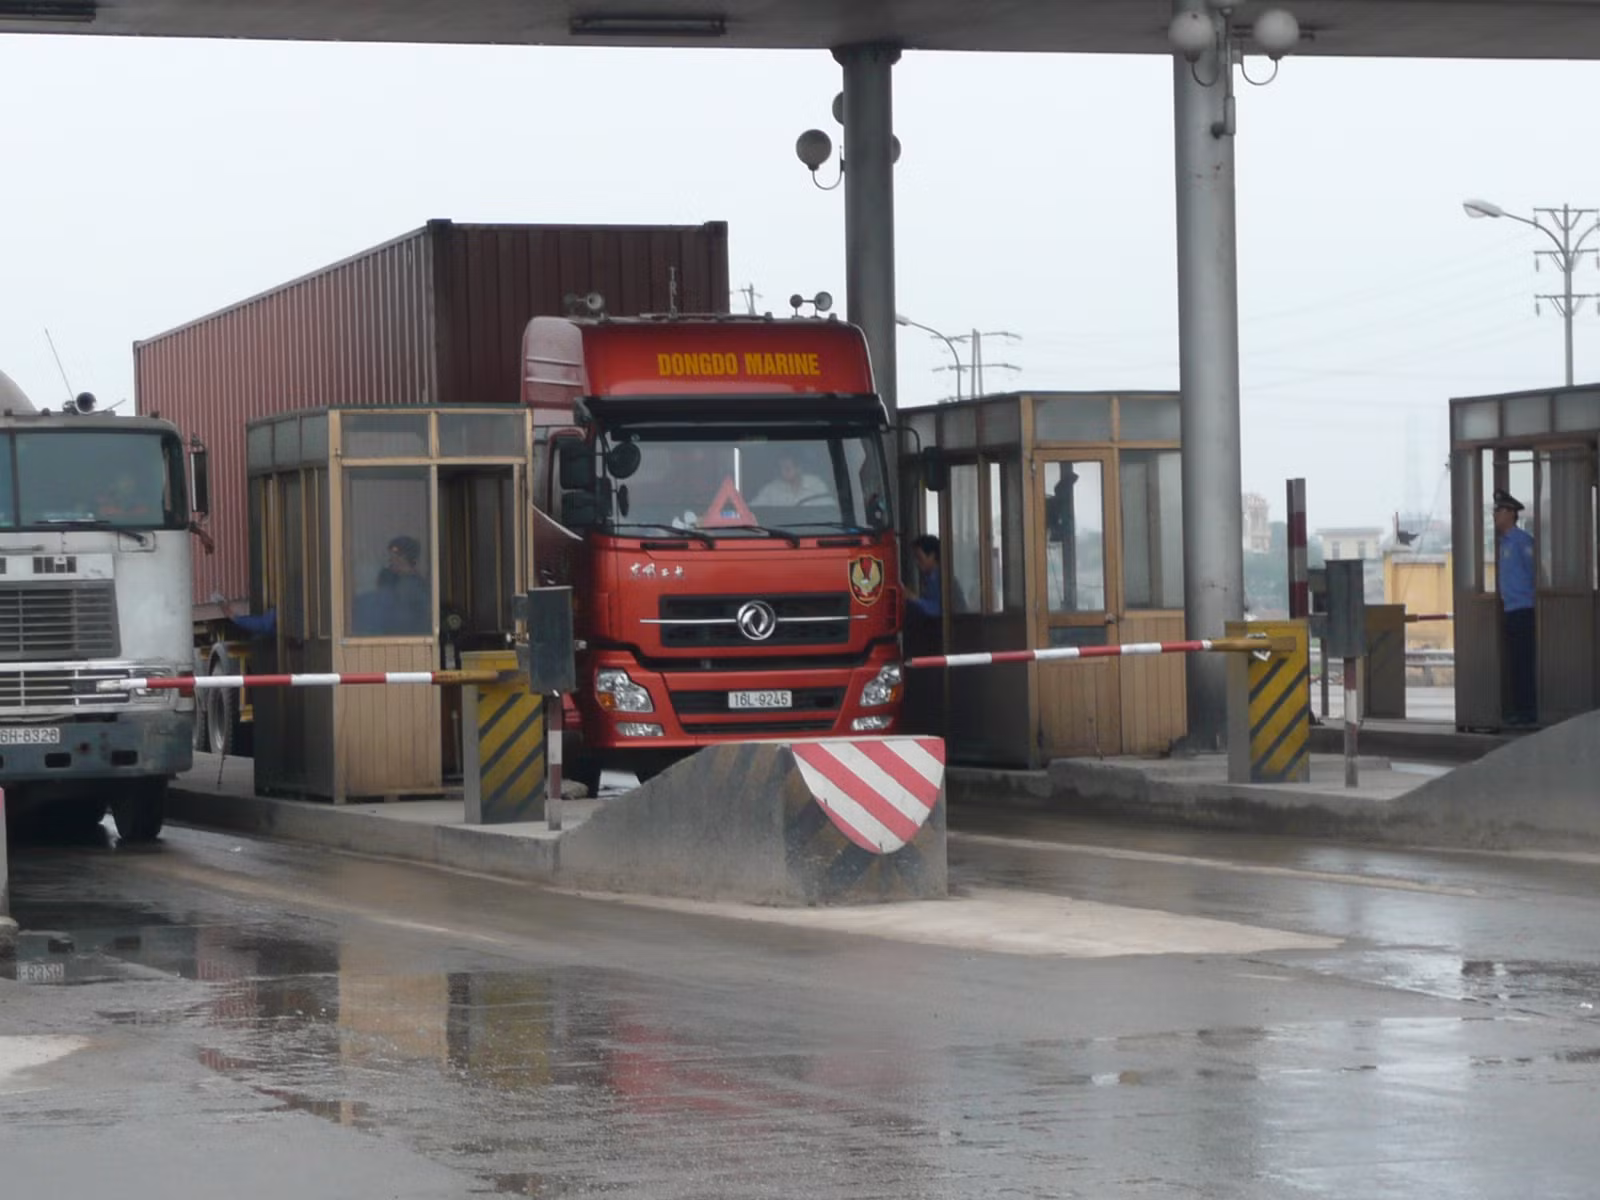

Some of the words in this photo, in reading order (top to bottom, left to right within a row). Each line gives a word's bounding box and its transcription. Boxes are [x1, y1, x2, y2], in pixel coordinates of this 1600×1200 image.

[657, 352, 738, 376] DONGDO
[744, 352, 821, 376] MARINE
[734, 692, 789, 706] 16L-9245
